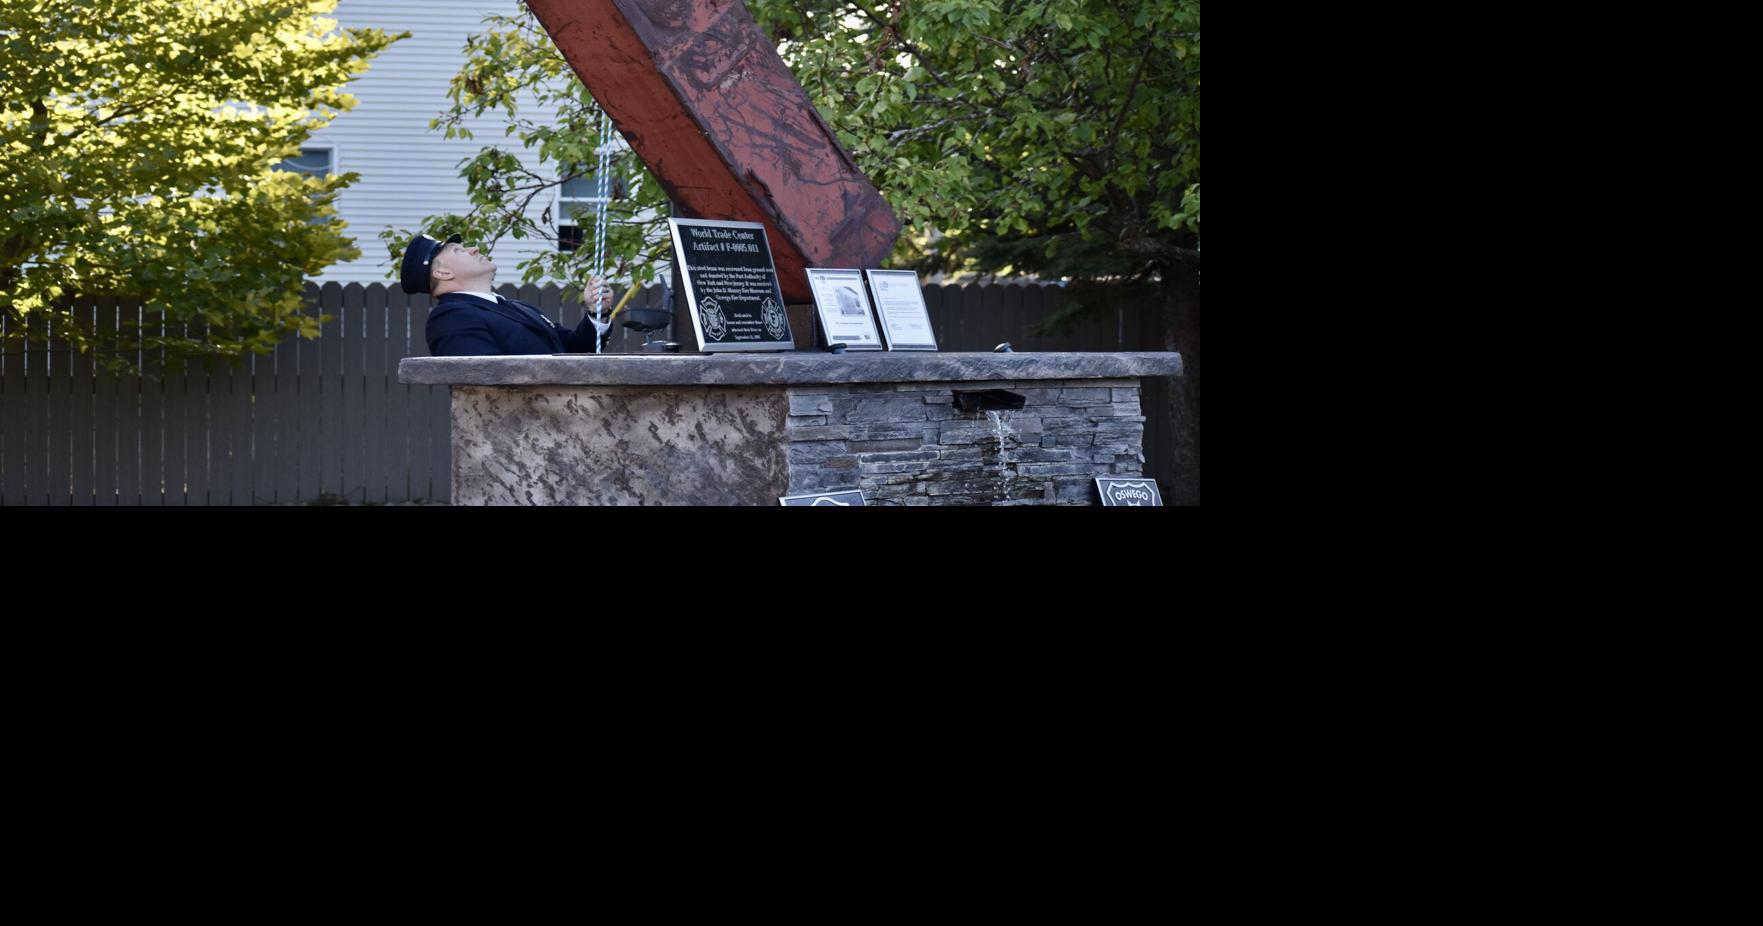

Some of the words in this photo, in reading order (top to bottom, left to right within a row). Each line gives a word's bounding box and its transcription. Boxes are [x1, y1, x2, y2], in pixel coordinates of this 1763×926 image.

[690, 228, 712, 238] World
[712, 229, 732, 239] Trade
[732, 230, 754, 240] Center
[693, 241, 720, 252] Artifact
[1115, 489, 1149, 500] OSWEGO
